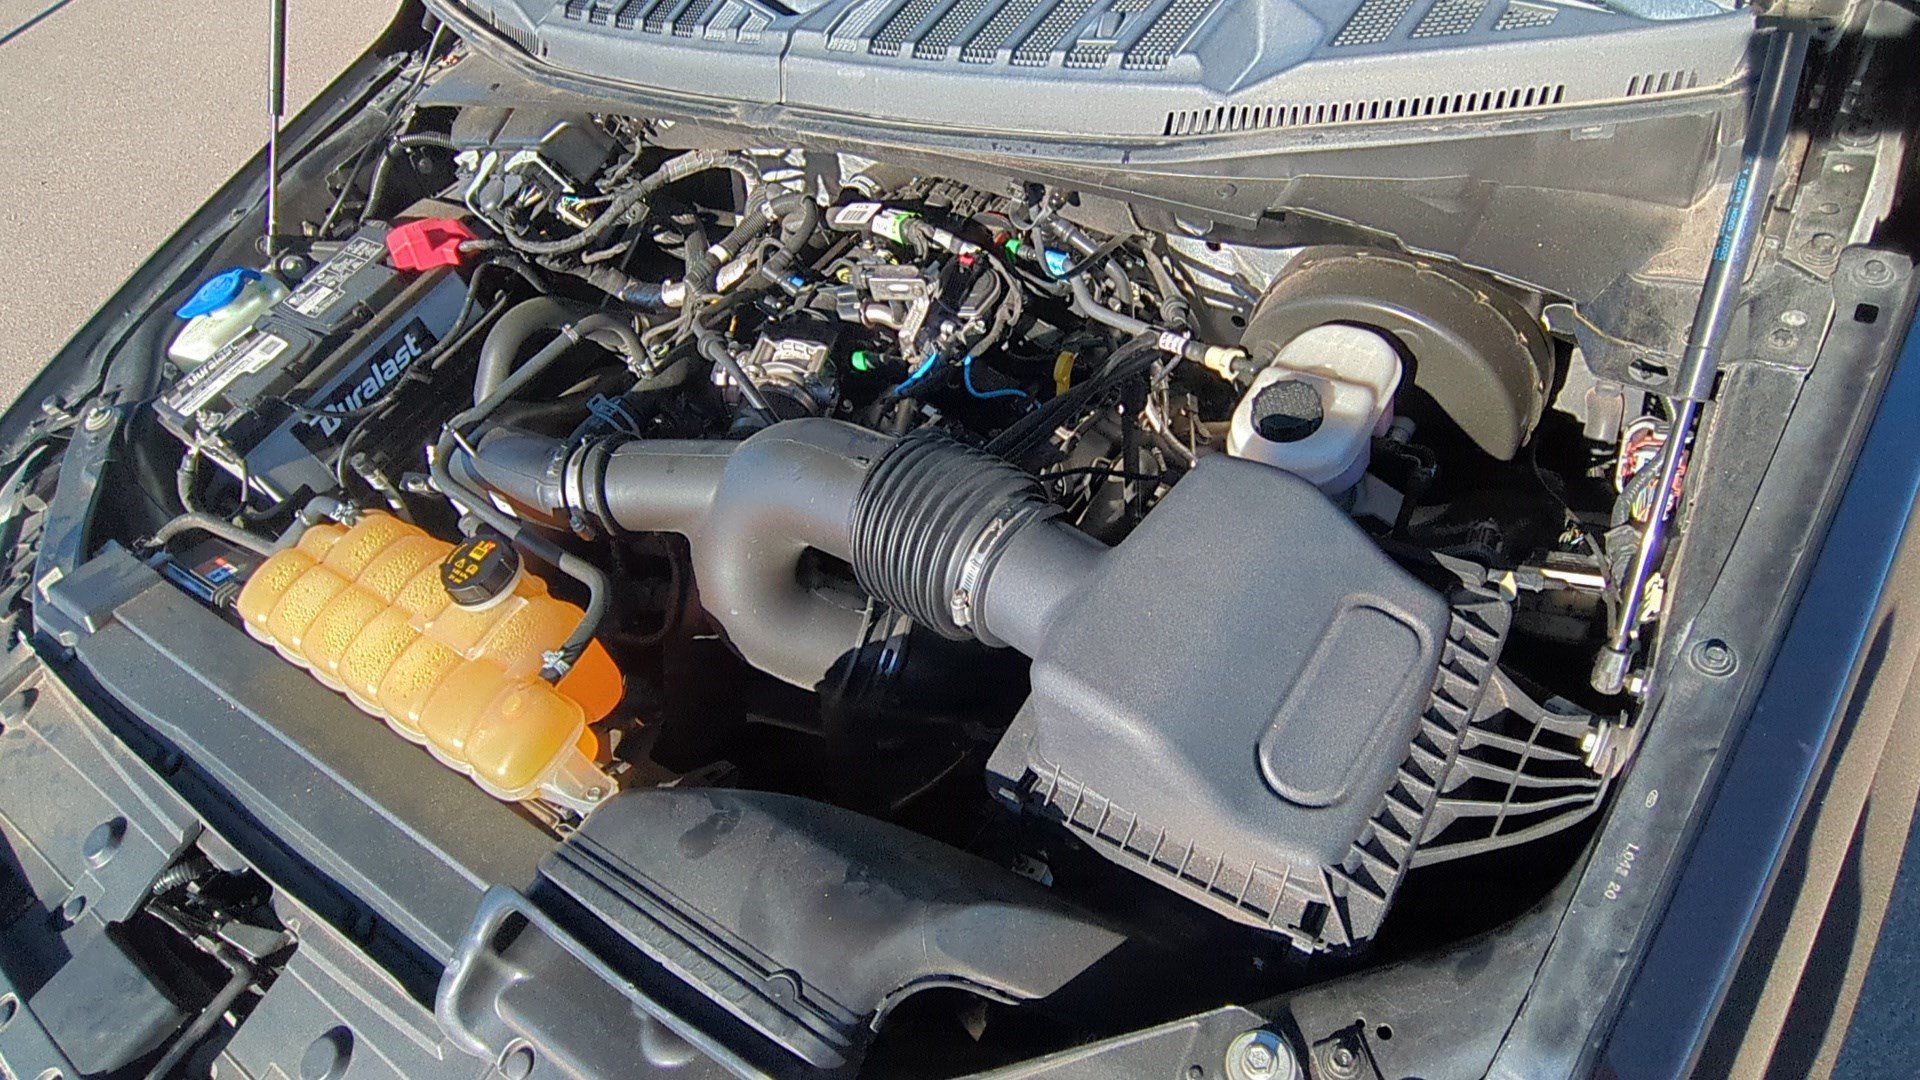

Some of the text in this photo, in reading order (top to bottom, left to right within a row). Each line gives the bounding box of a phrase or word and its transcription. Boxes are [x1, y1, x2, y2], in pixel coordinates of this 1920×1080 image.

[186, 344, 239, 387] Duralast
[309, 333, 422, 438] Duralast
[1604, 881, 1621, 899] 20
